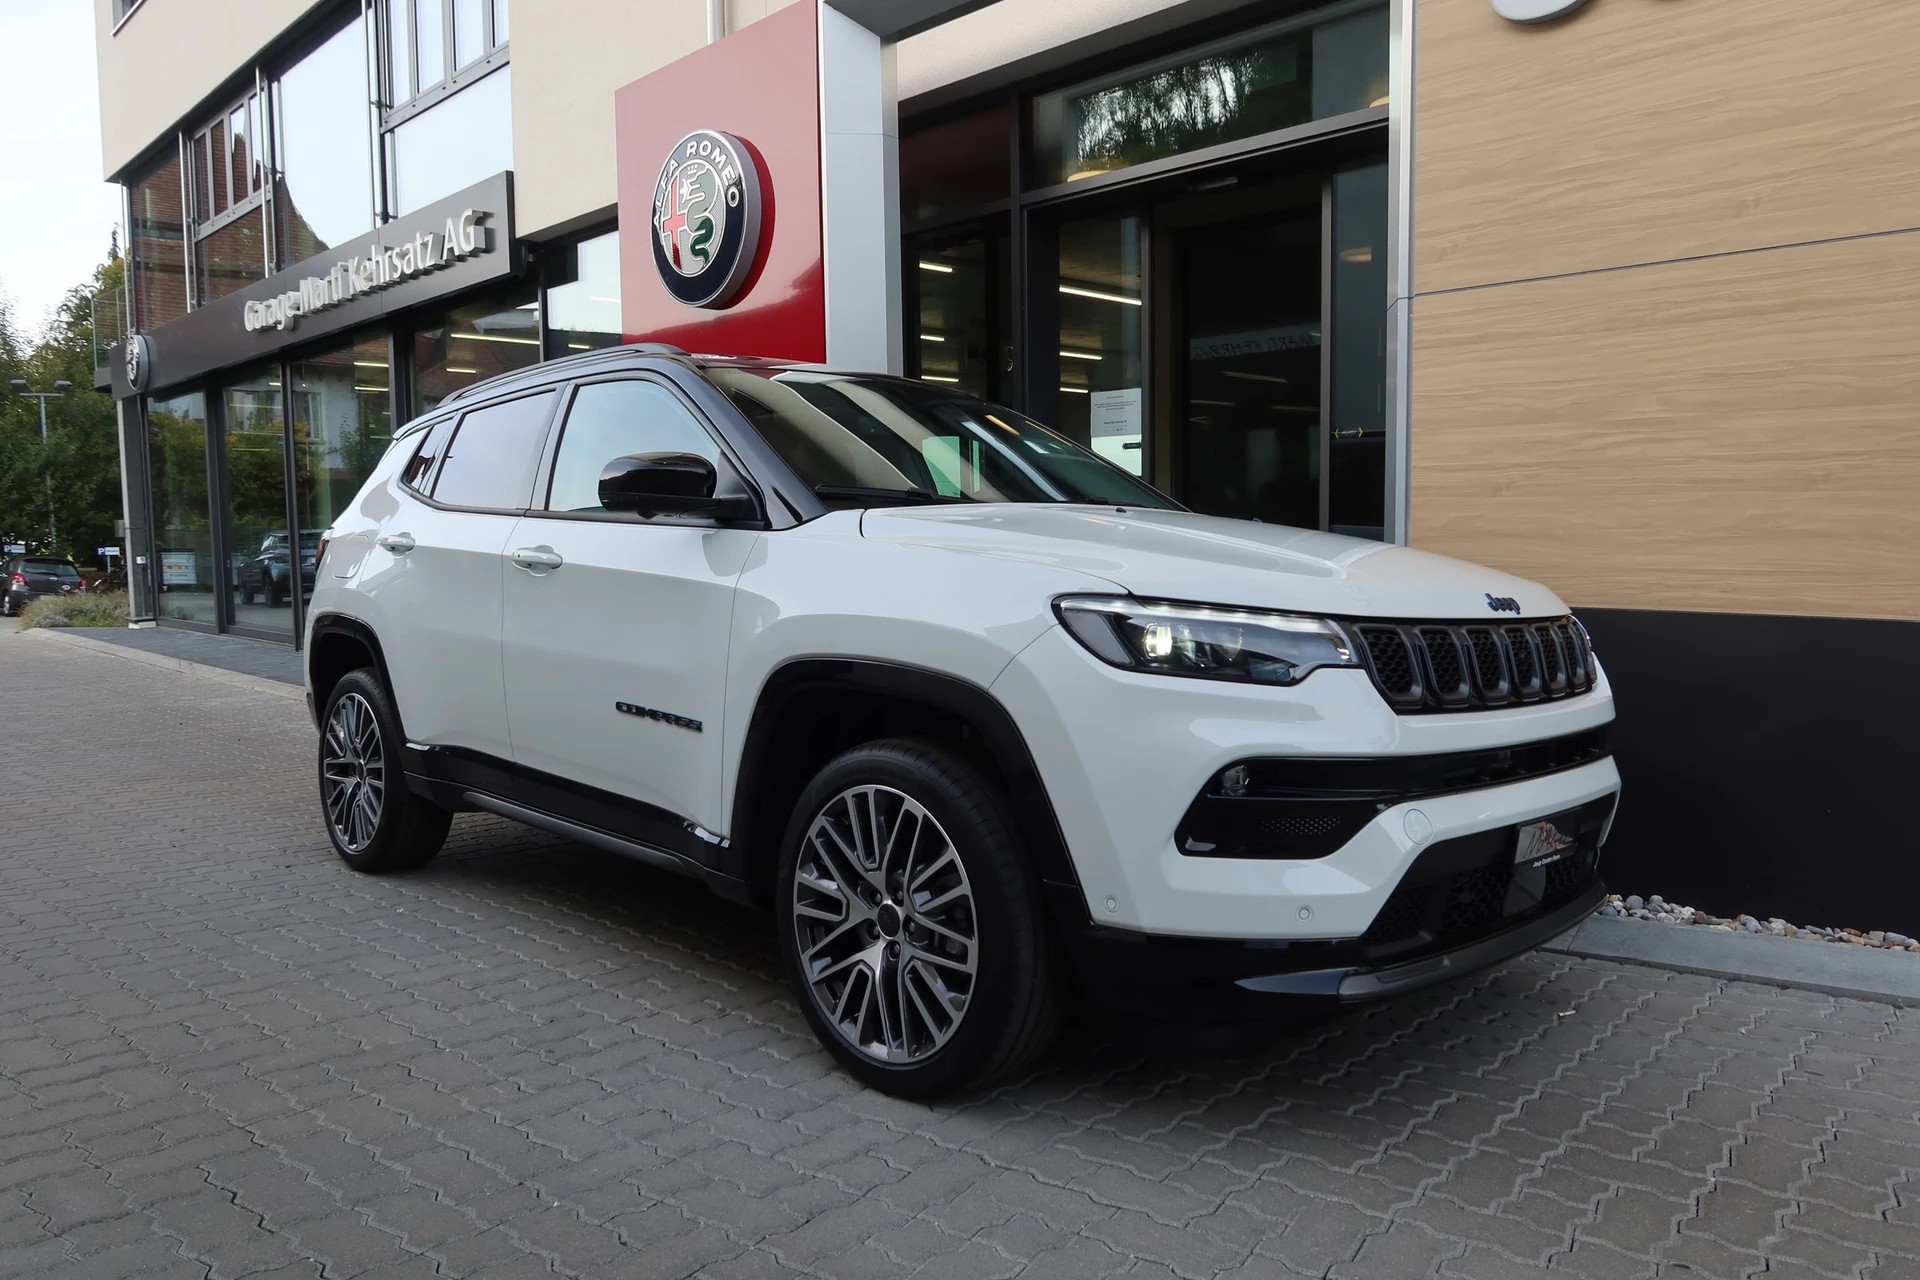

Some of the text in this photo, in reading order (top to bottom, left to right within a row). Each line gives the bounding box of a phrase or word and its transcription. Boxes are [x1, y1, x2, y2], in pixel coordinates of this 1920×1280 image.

[652, 140, 740, 230] ALFA ROMEO
[243, 290, 301, 332] Garage
[349, 231, 438, 293] Kehrsatz
[443, 208, 485, 261] AG
[1484, 592, 1521, 616] Jeep
